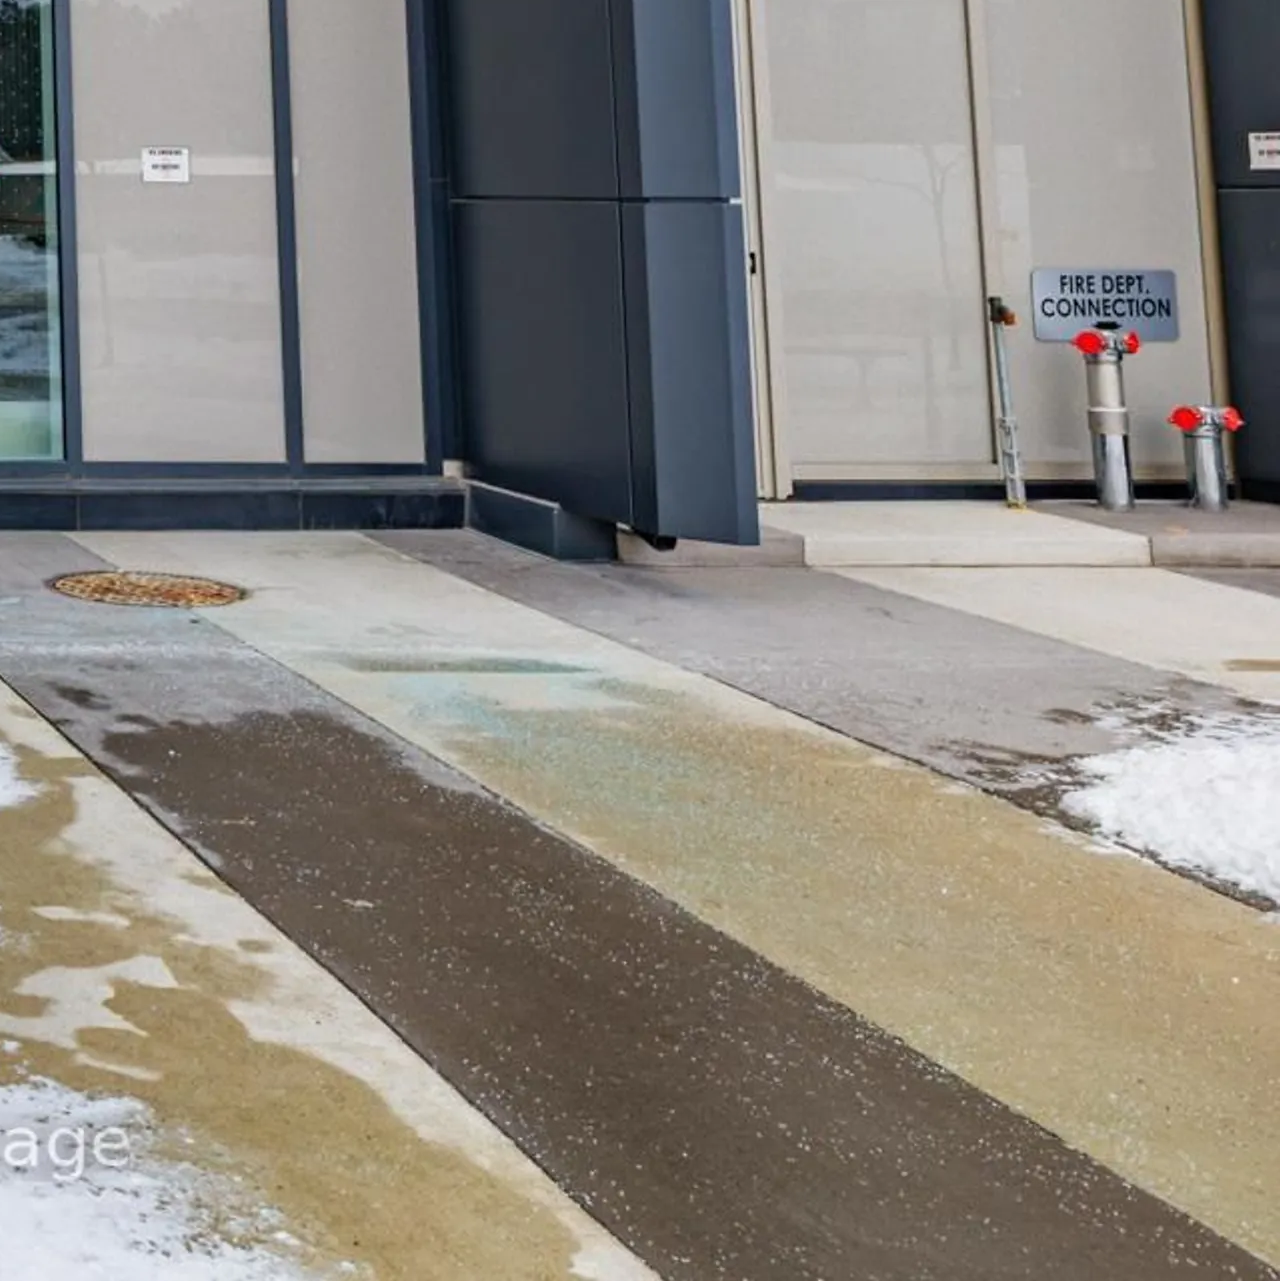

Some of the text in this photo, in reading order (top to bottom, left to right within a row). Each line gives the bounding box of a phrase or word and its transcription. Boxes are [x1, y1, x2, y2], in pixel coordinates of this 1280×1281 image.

[1060, 274, 1150, 294] FIRE DEPT.
[1041, 298, 1171, 317] CONNECTION
